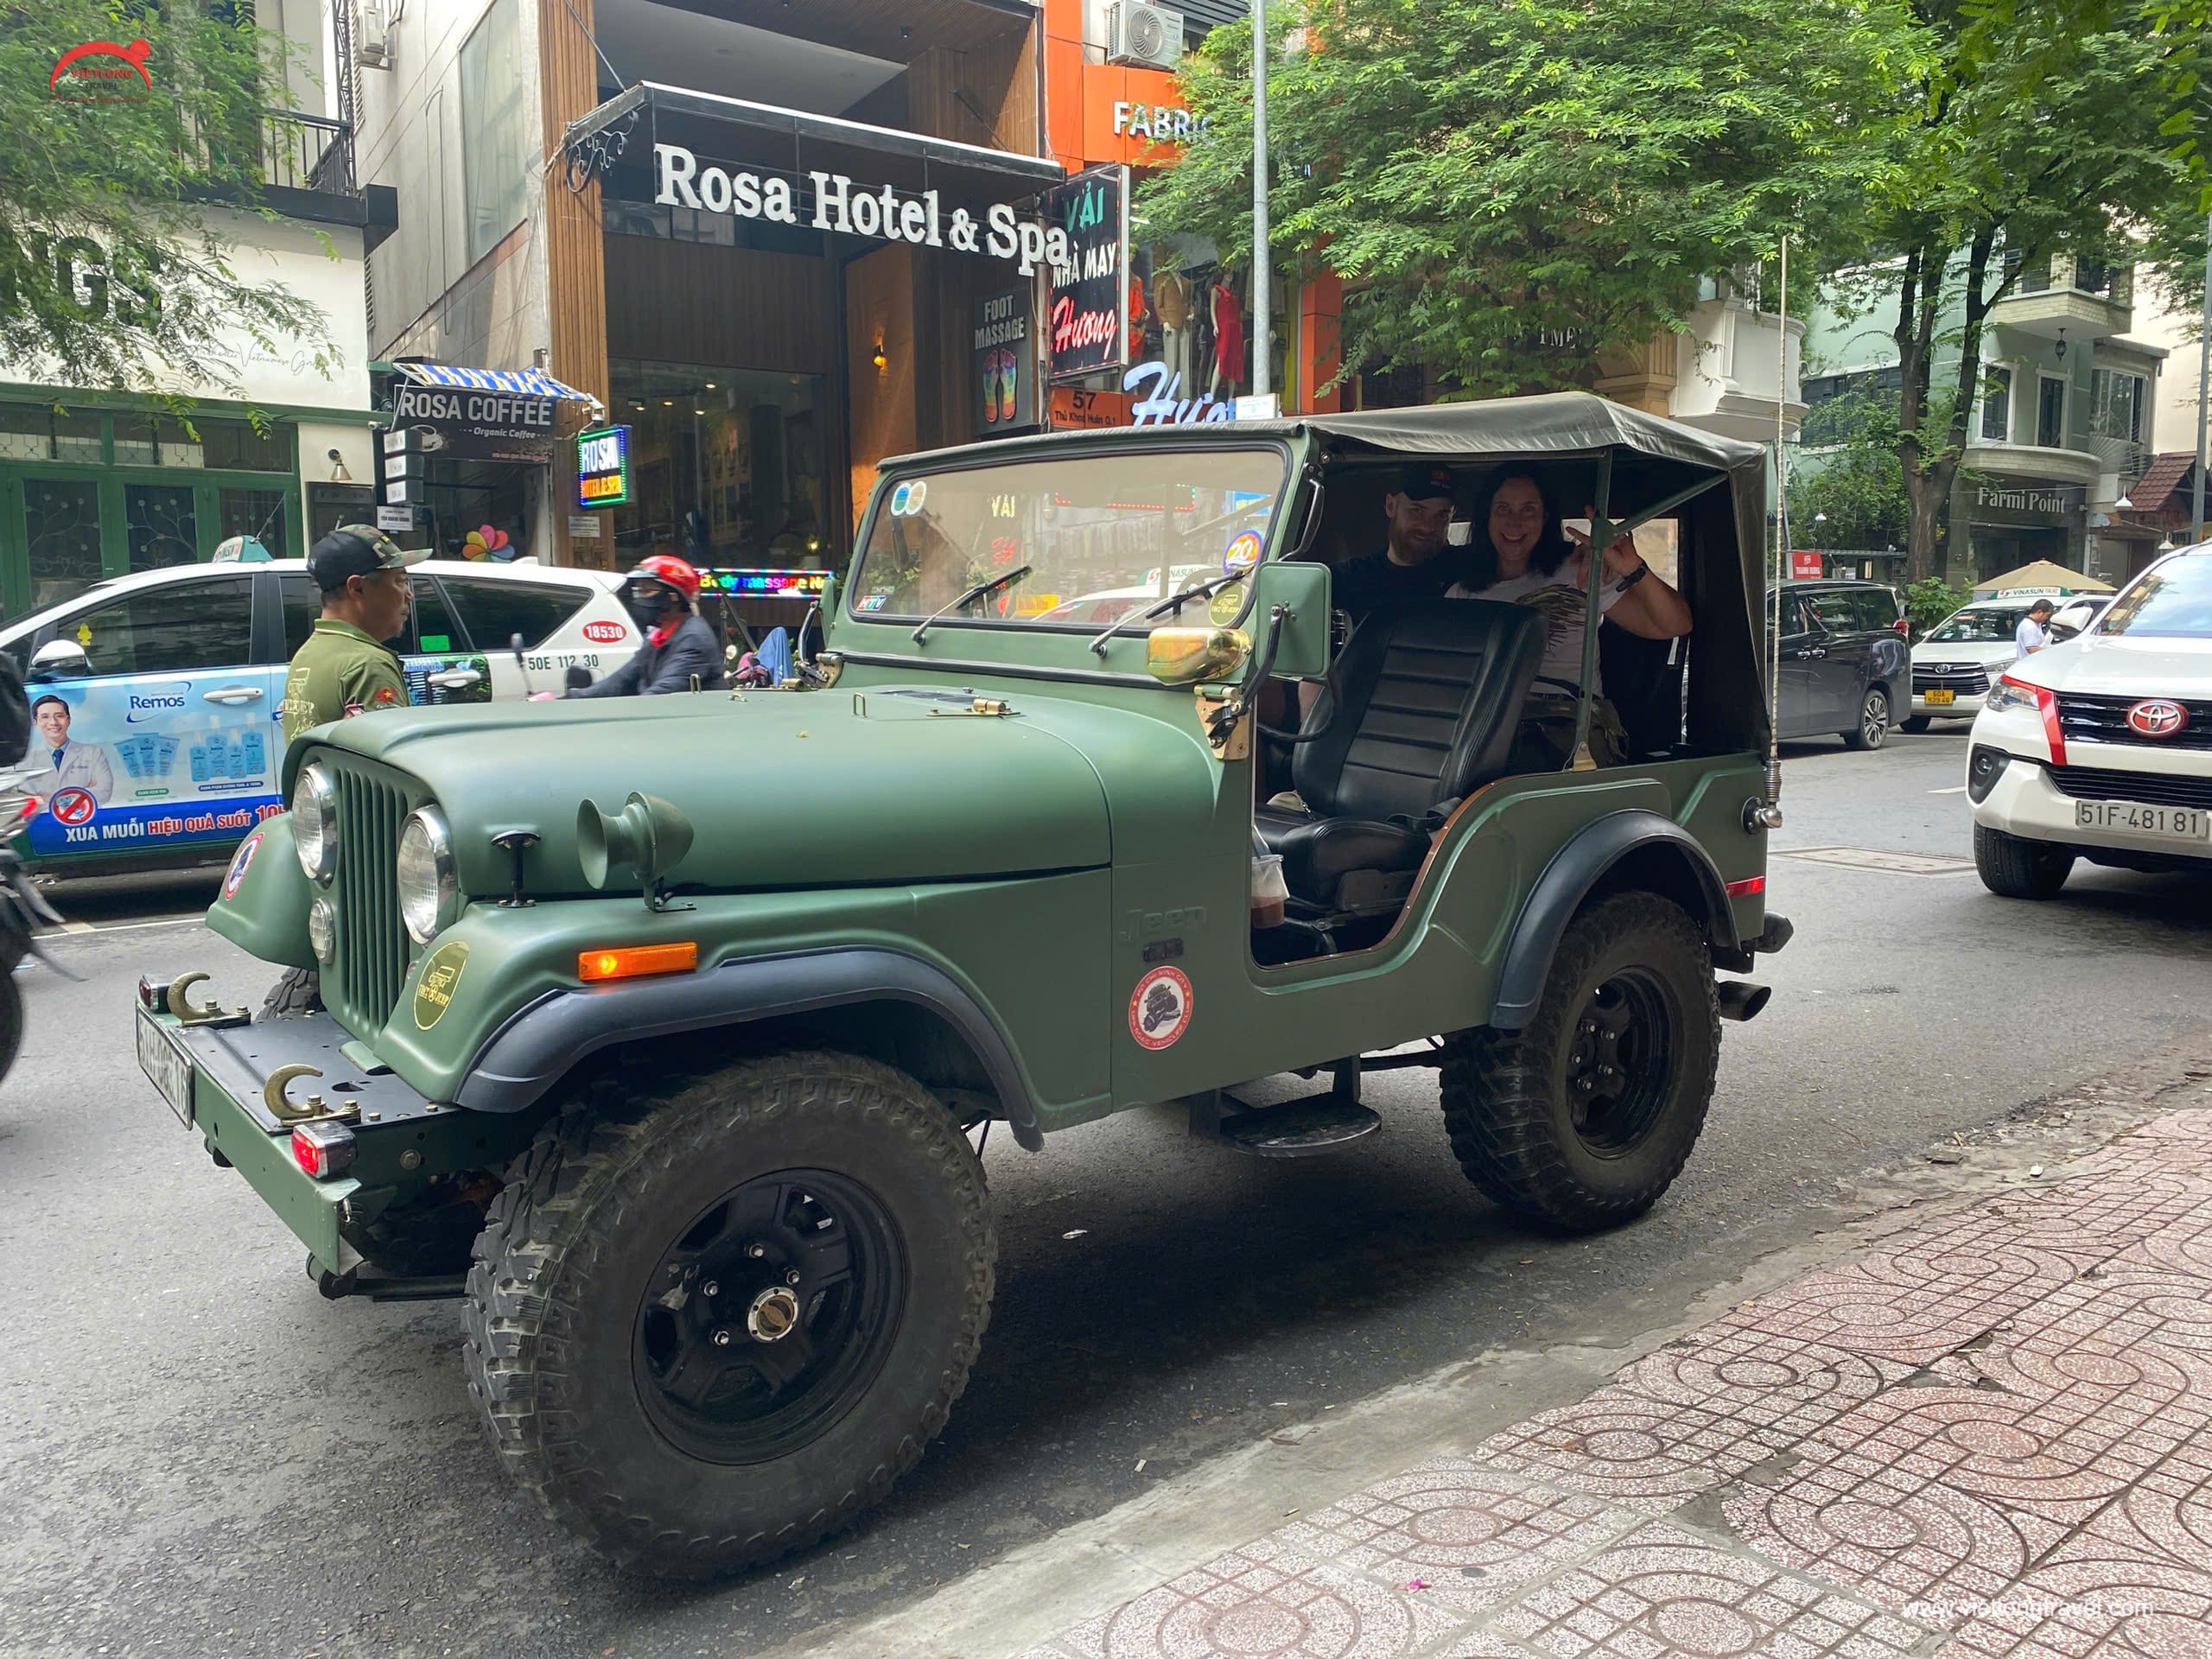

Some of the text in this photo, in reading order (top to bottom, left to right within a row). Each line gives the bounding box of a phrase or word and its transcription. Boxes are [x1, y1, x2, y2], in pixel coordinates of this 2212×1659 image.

[653, 143, 1071, 277] Rosa Hotel & Spa
[1084, 242, 1117, 281] MAY
[984, 295, 1014, 322] FOOT
[975, 316, 1025, 350] MASSAGE
[400, 392, 552, 426] ROSA COFFEE
[1072, 391, 1097, 410] 57
[474, 427, 536, 439] Organic Coffee
[582, 436, 620, 474] ROSA
[1978, 486, 2066, 513] Farmi Point
[586, 626, 623, 639] 18530
[528, 657, 551, 670] 50E
[583, 654, 600, 667] 30
[130, 696, 185, 709] Remos
[66, 826, 98, 843] XUA
[102, 817, 144, 839] MUỖI
[148, 818, 182, 836] HIỆU
[186, 814, 214, 832] QUẢ
[217, 808, 251, 828] SUỐT
[2081, 804, 2196, 834] 51F-481 81
